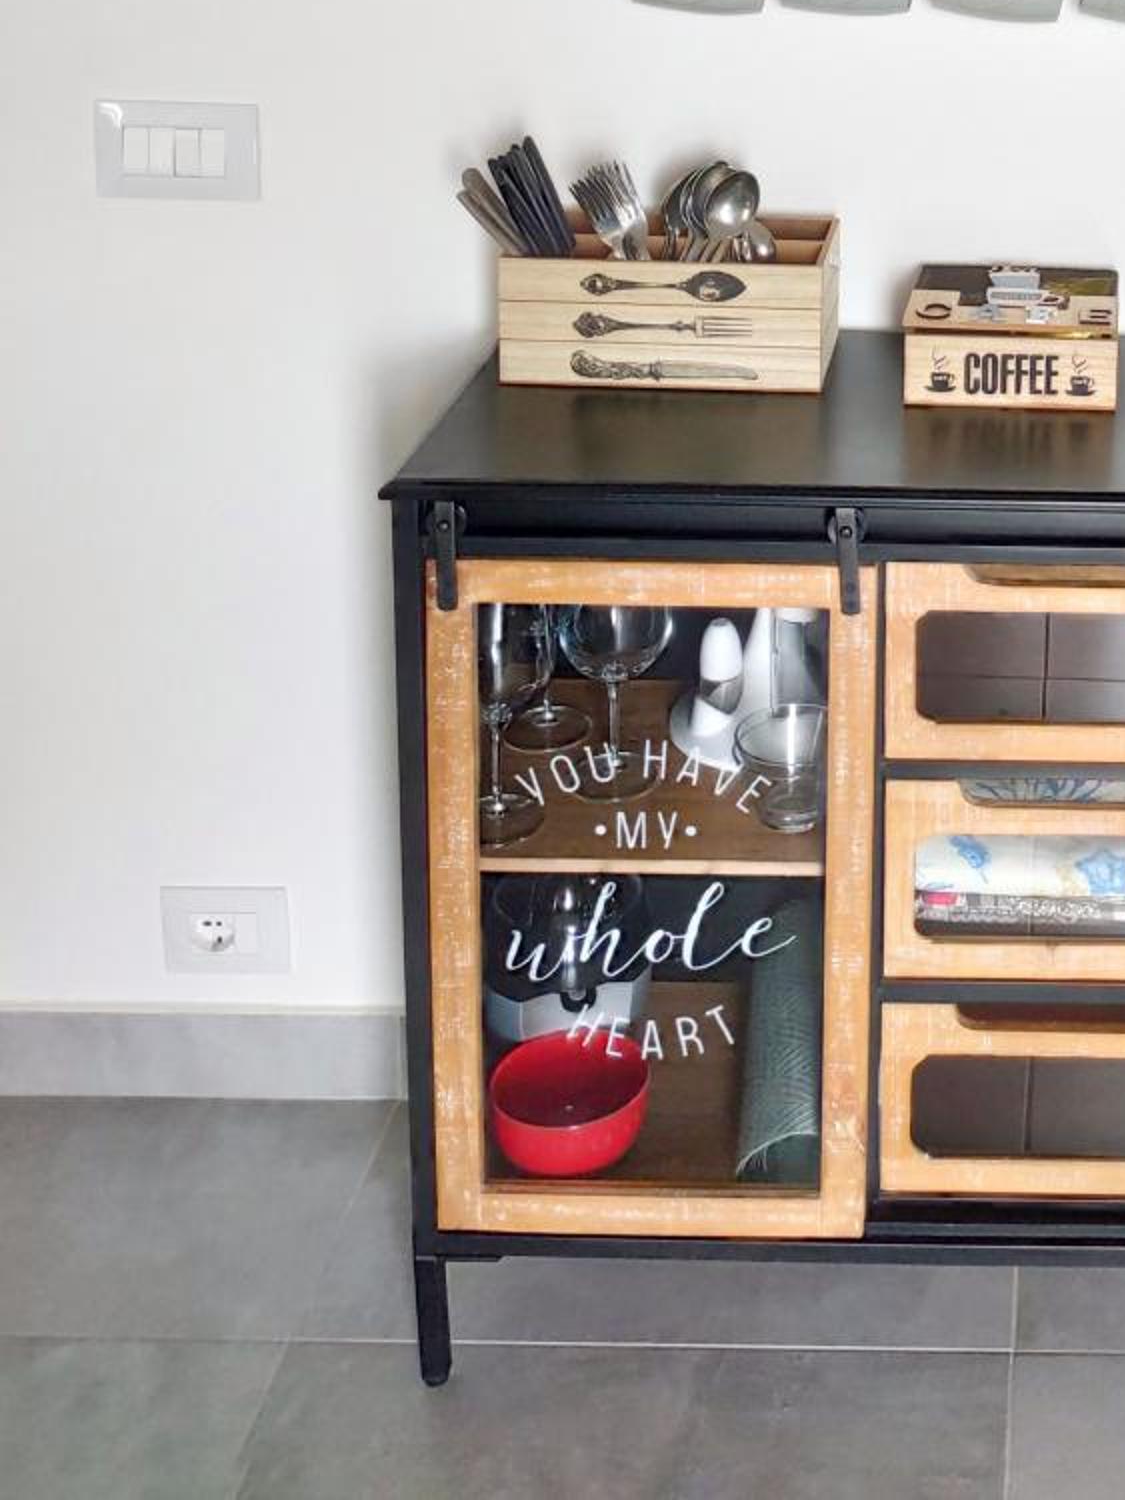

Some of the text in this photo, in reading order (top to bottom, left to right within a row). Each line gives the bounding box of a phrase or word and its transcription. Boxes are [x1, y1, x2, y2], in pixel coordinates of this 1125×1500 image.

[964, 353, 1059, 395] COFFEE
[515, 739, 772, 814] YOU HAVE
[505, 881, 796, 982] whole
[566, 1003, 736, 1061] HEART
